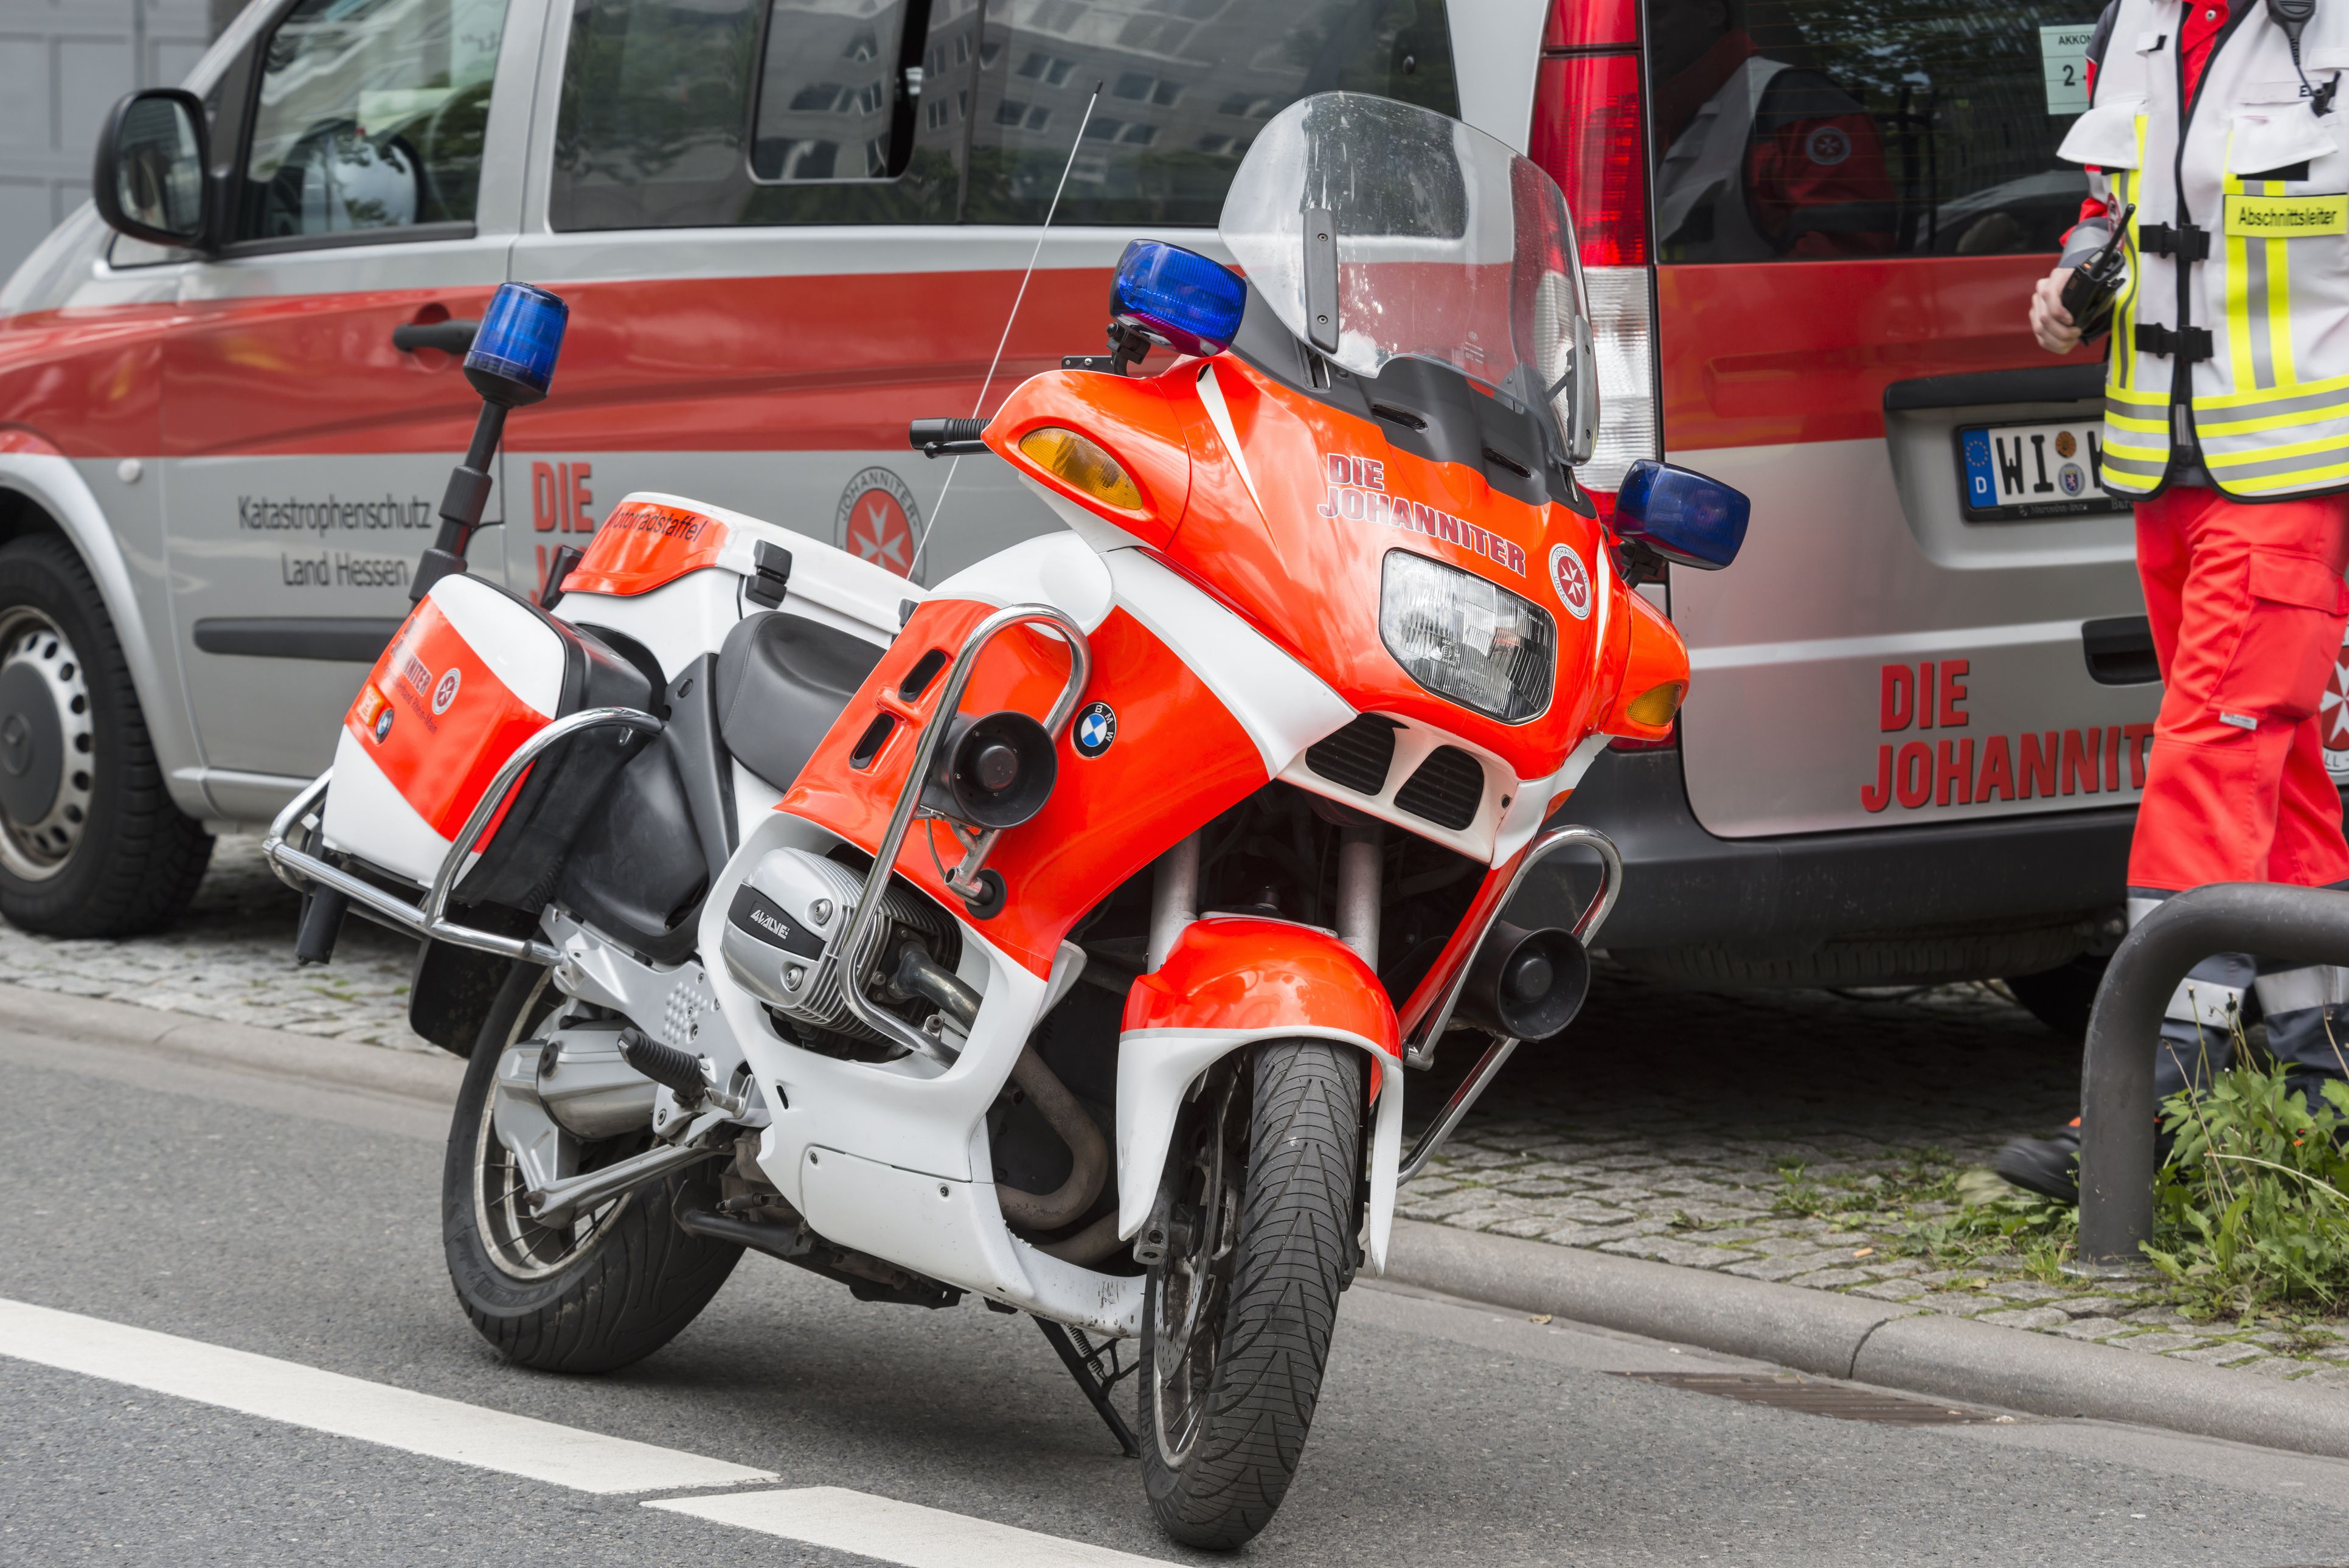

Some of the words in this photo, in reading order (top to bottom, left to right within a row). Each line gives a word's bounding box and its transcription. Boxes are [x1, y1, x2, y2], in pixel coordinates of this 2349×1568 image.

[2238, 207, 2337, 226] Abschnittsleiter
[1327, 453, 1384, 491] DIE
[1996, 435, 2054, 496] WI
[531, 462, 595, 533] DIE
[1976, 477, 1988, 493] D
[238, 493, 432, 537] Katastrophenschutz
[605, 506, 709, 542] Motorradstaffel
[1317, 487, 1527, 578] JOHANNITER
[282, 551, 330, 586] Land
[336, 552, 410, 586] Hessen
[1880, 659, 1969, 732] DIE
[1095, 704, 1114, 742] BMW
